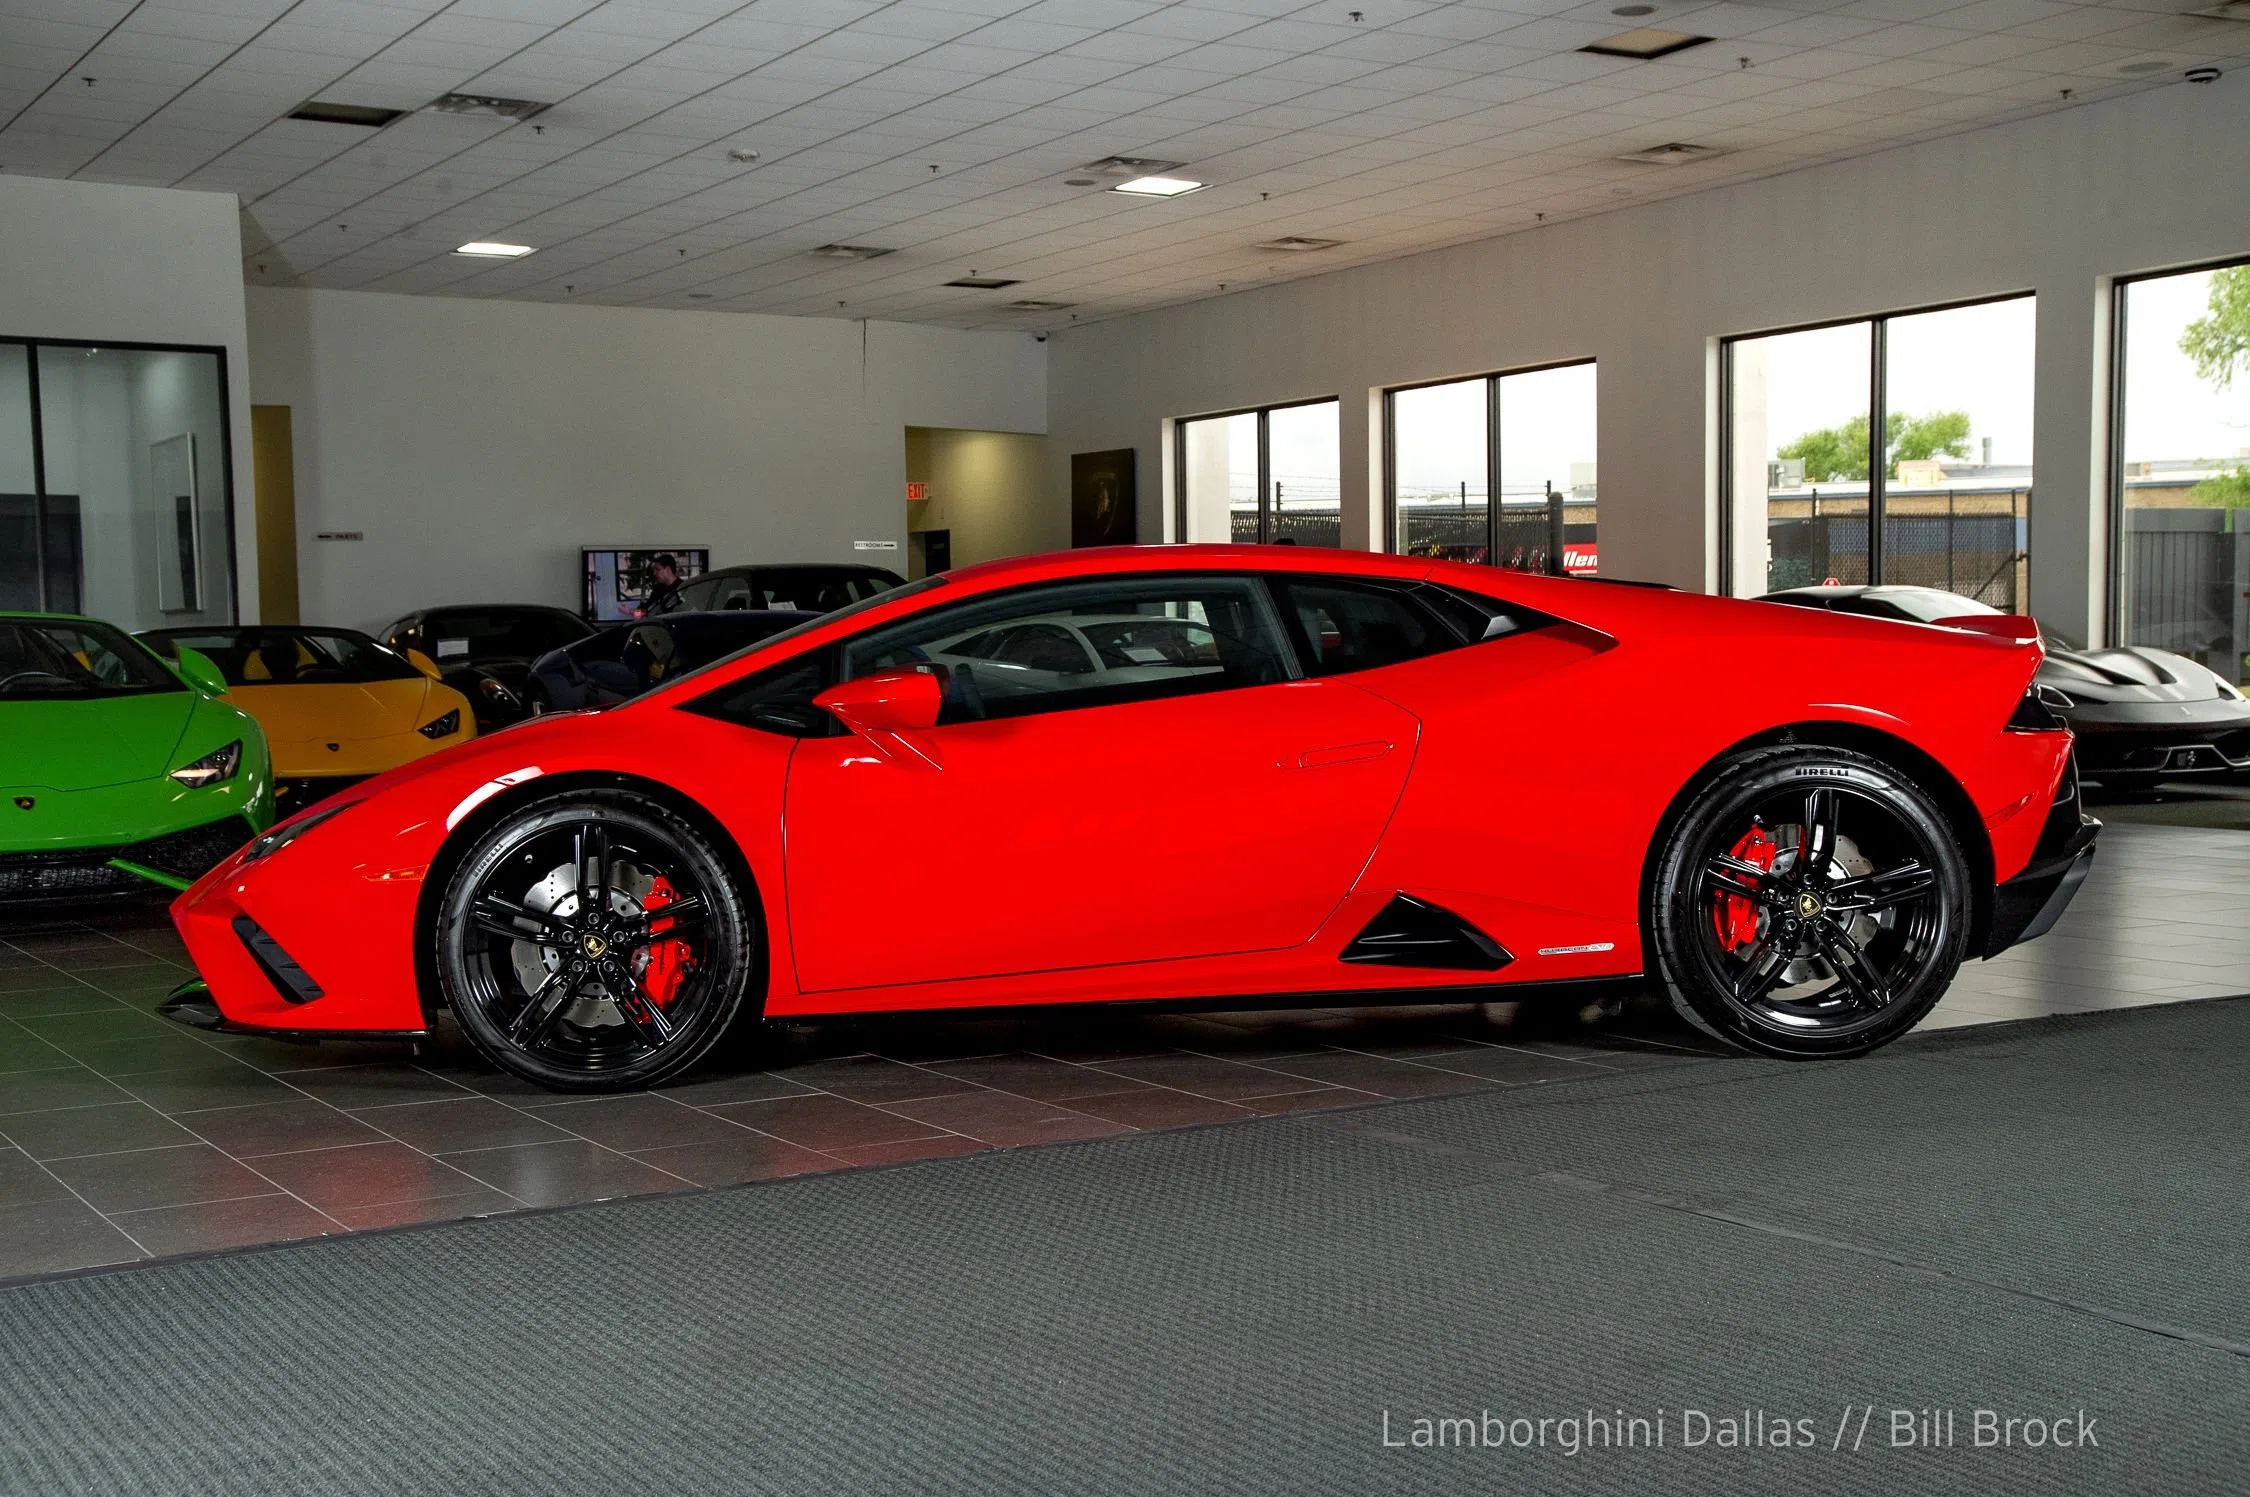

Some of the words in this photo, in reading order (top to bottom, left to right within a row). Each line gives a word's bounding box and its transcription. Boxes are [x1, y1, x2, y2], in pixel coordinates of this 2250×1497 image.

[908, 483, 925, 499] EXIT
[1795, 766, 1850, 777] PIRELLI
[471, 842, 504, 878] PIRELLI
